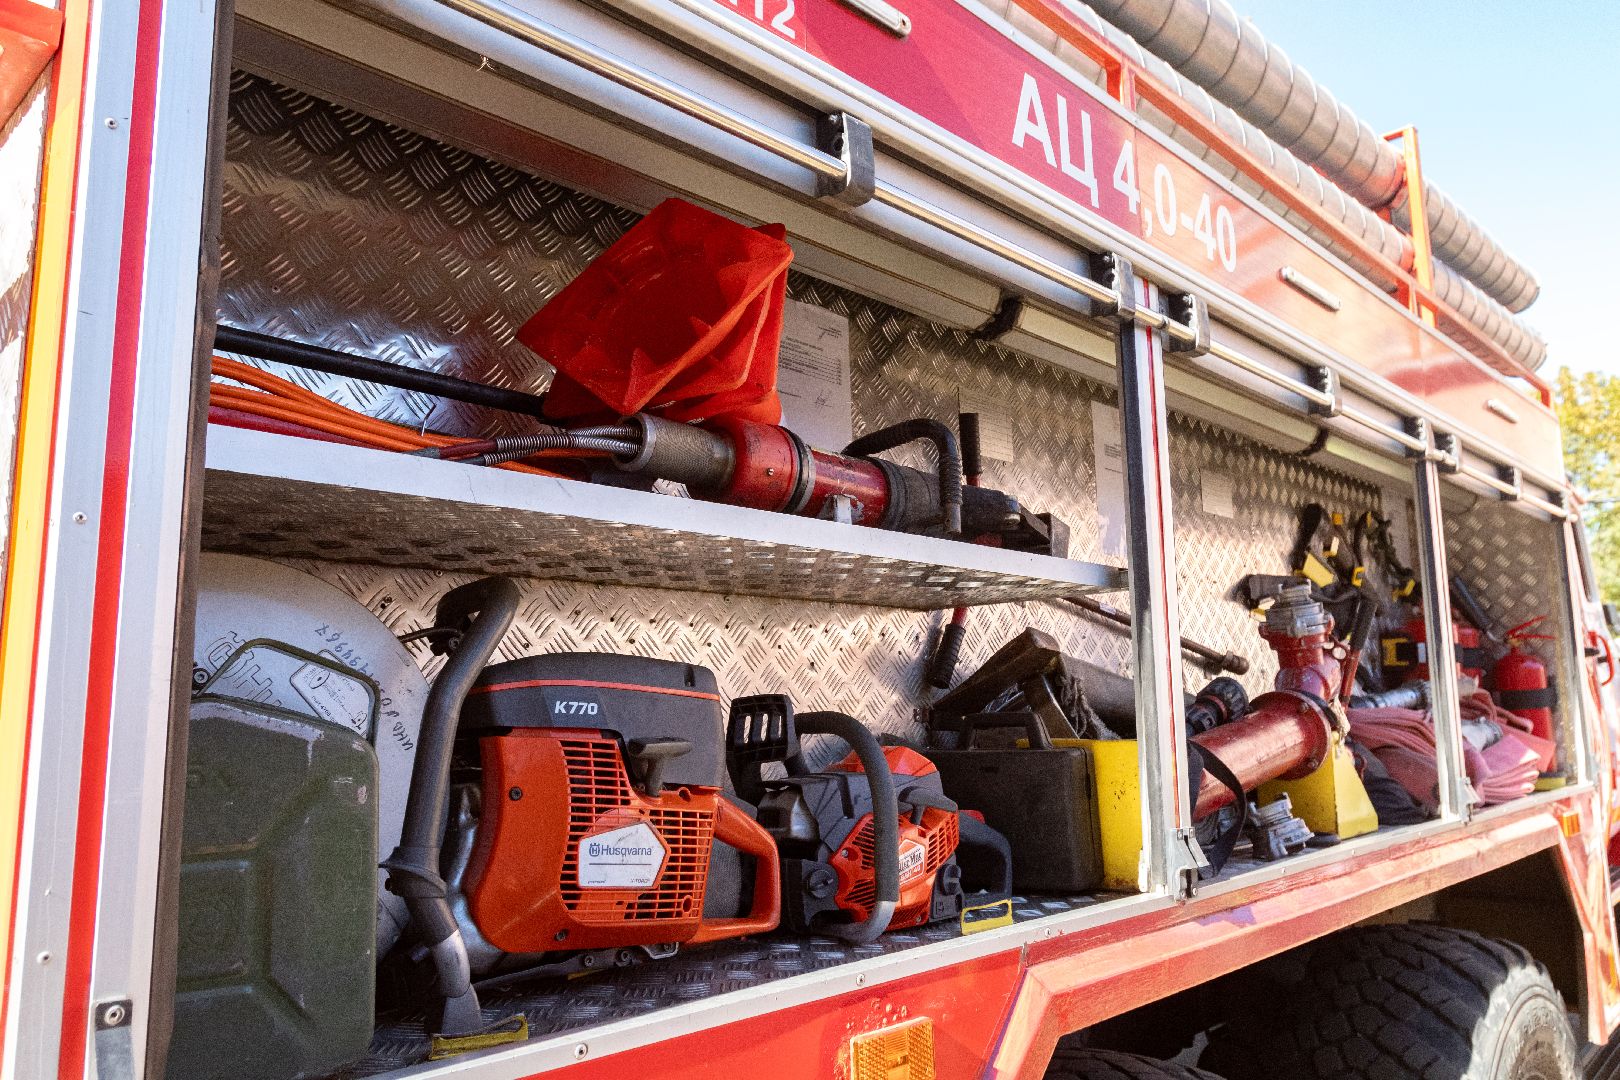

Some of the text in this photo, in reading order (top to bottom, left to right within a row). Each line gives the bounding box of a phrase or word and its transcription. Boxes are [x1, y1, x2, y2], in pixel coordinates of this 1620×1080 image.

[1012, 72, 1237, 272] АЦ 4,0-40
[601, 844, 652, 857] Husqvarna
